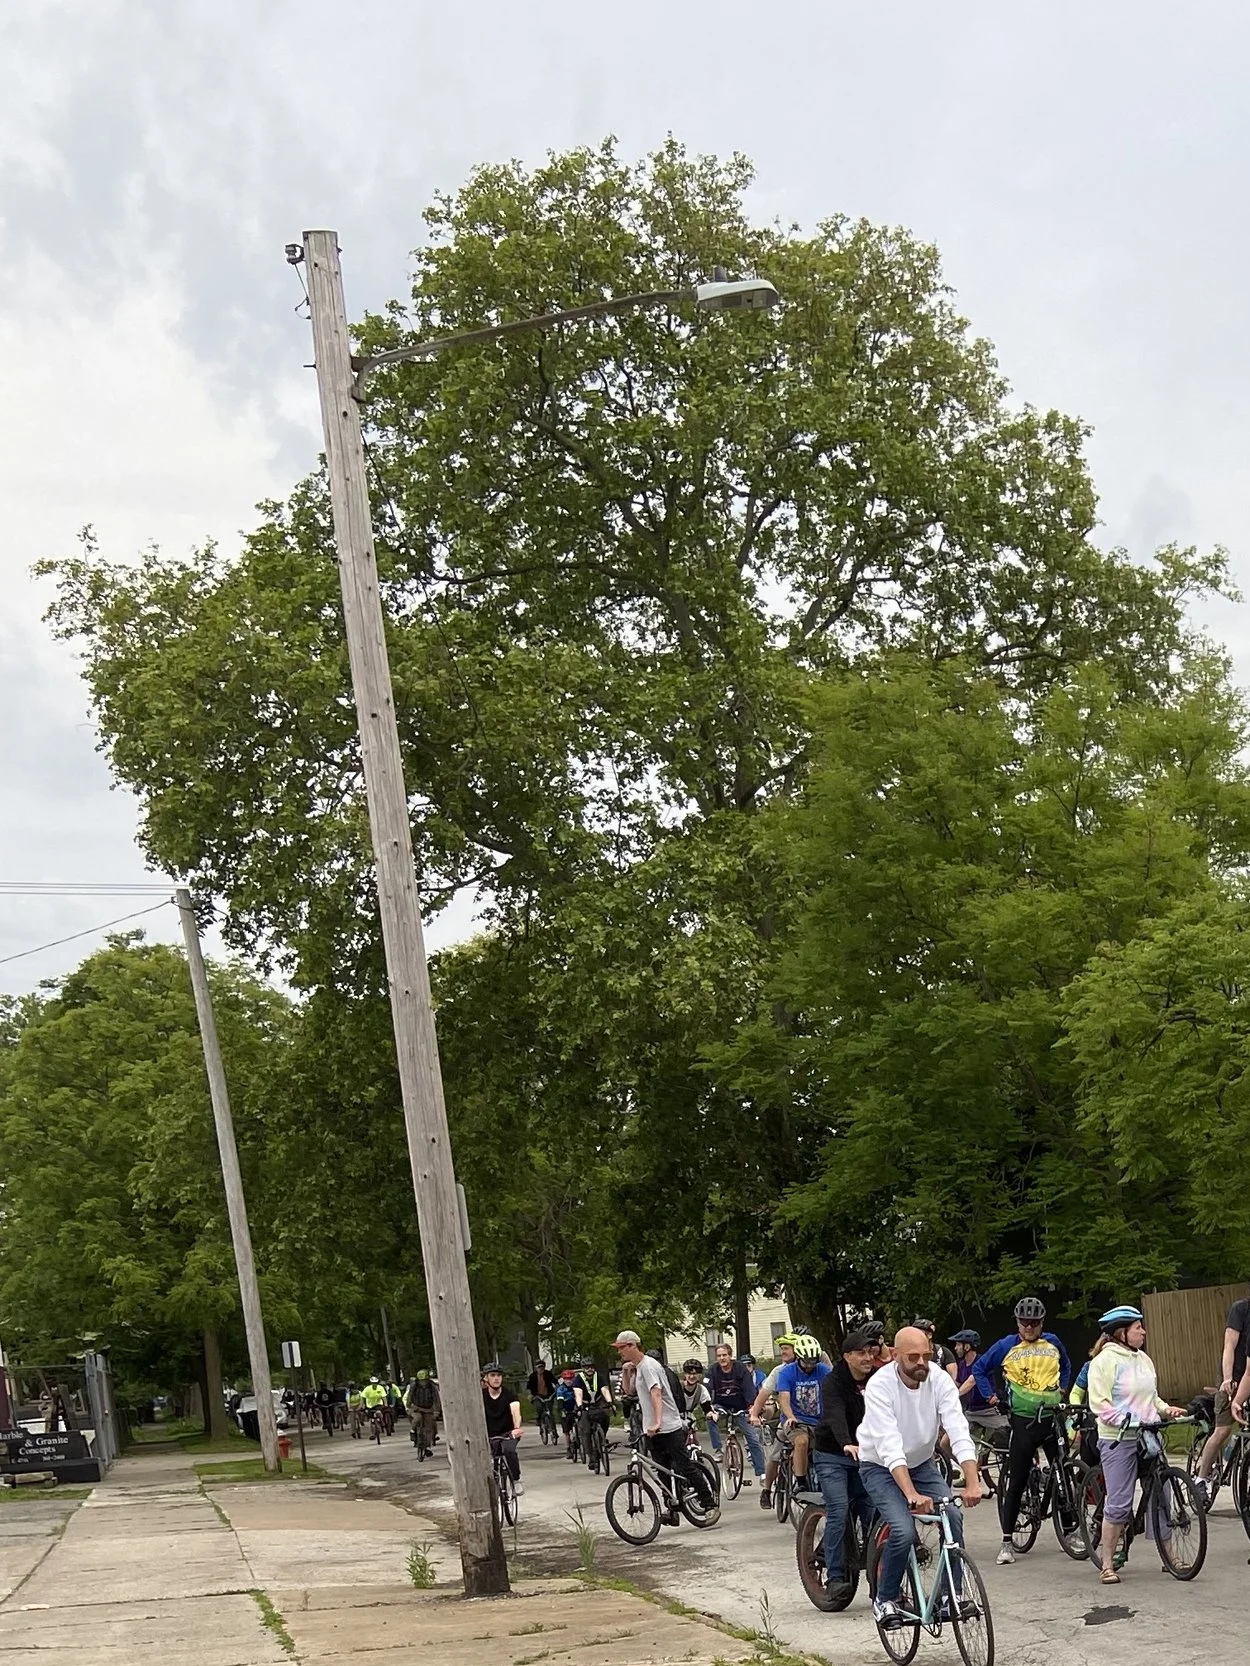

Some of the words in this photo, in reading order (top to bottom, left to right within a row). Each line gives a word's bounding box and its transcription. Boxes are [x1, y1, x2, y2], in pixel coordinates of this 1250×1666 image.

[24, 1439, 34, 1447] &
[35, 1435, 69, 1446] Granite
[19, 1446, 57, 1455] Concepts
